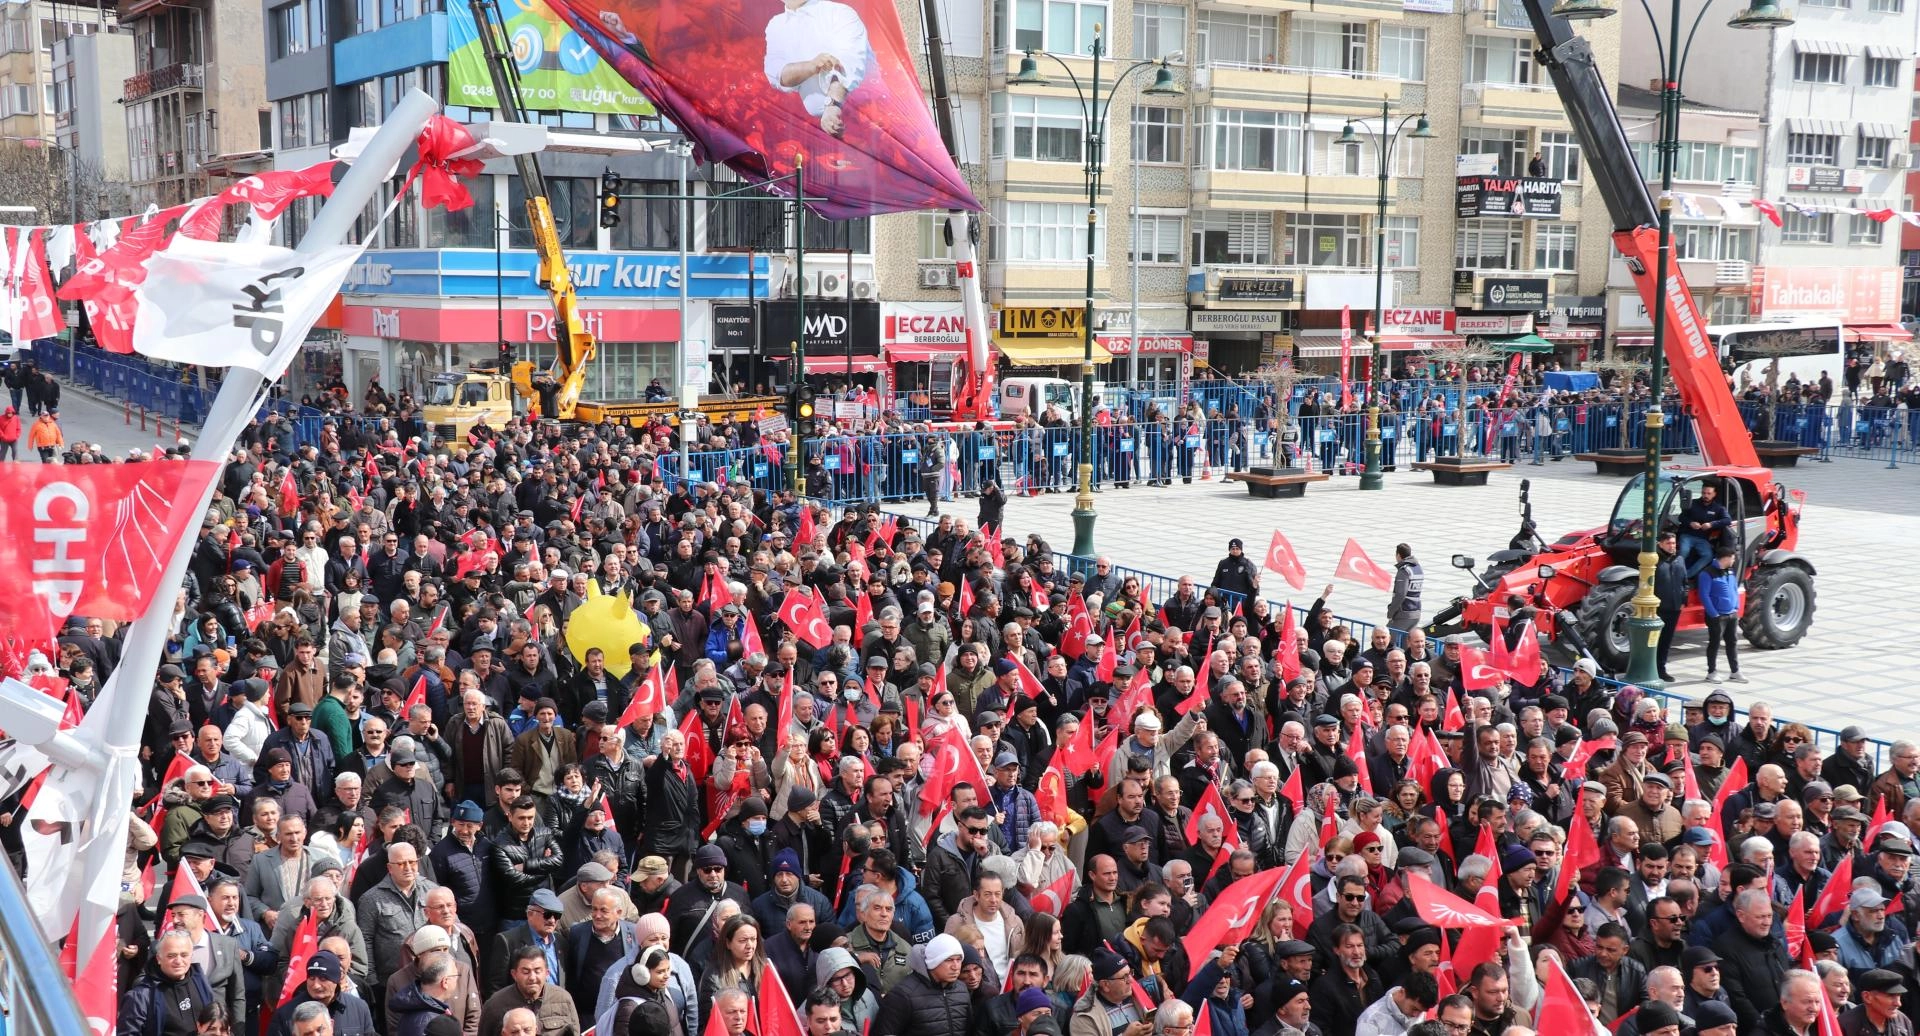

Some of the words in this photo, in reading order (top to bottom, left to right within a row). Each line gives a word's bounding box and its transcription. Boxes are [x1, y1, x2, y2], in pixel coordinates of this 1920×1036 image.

[462, 84, 494, 97] 0248
[538, 89, 556, 100] 00
[582, 84, 620, 106] uğur
[1483, 179, 1517, 192] TALAY
[1524, 181, 1562, 194] HARİTA
[614, 257, 682, 288] kurs
[1771, 279, 1845, 305] Tahtakale
[527, 311, 603, 342] Peti
[803, 313, 847, 338] MAD
[898, 315, 965, 333] ECZAN
[1197, 313, 1249, 323] BERBEROĞLU
[1251, 314, 1277, 323] PASAJI
[1383, 309, 1442, 325] ECZANE
[1666, 275, 1708, 359] MANITOU
[914, 334, 960, 343] BERBEROĞLU
[1143, 336, 1182, 351] DÖNER
[32, 481, 90, 618] CHP
